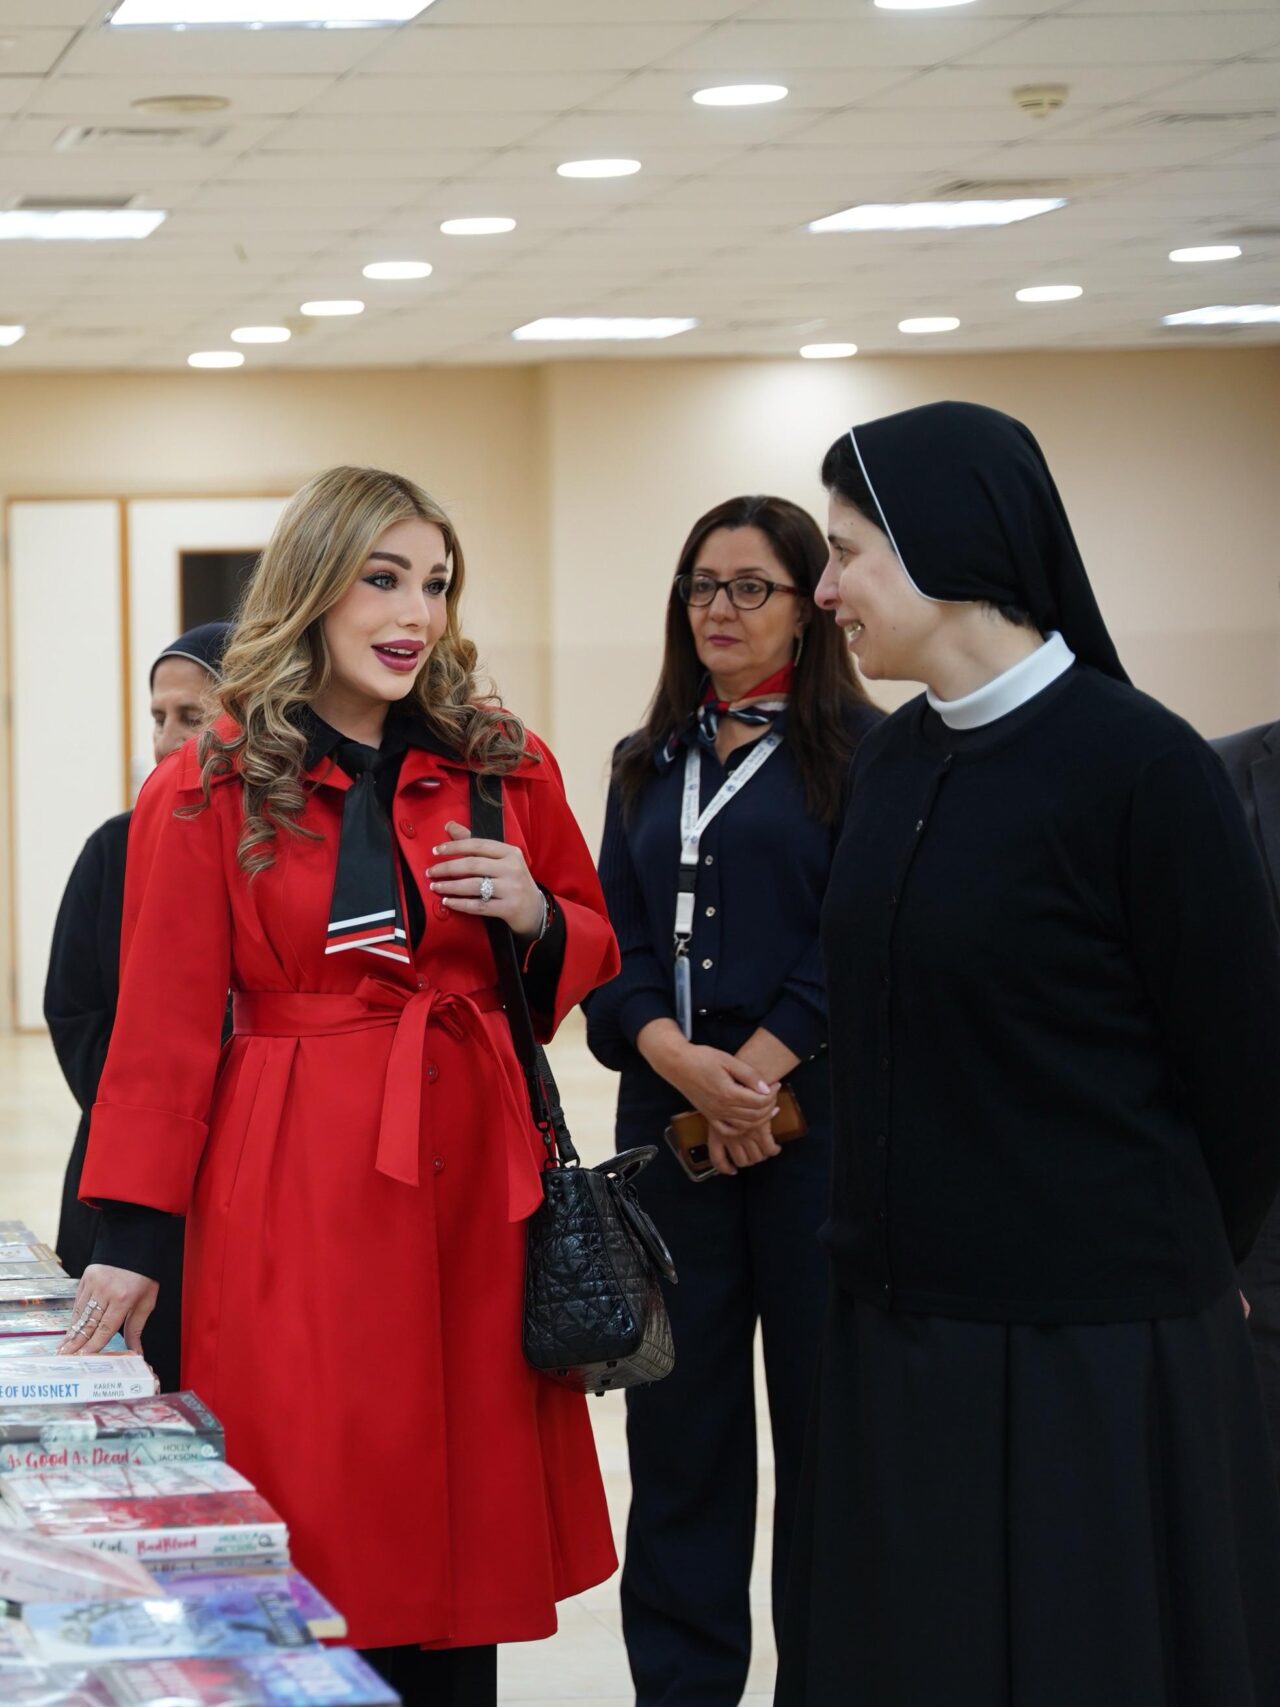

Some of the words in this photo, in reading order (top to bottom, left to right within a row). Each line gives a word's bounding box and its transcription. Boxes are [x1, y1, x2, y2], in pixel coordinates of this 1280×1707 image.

[5, 1384, 20, 1398] OF
[22, 1384, 37, 1398] US
[38, 1384, 49, 1398] IS
[50, 1383, 80, 1399] NEXT
[163, 1443, 192, 1452] HOLLY
[7, 1454, 22, 1469] As
[25, 1448, 68, 1470] Good
[73, 1450, 88, 1465] As
[92, 1447, 130, 1465] Dead
[158, 1453, 199, 1462] JACKSON
